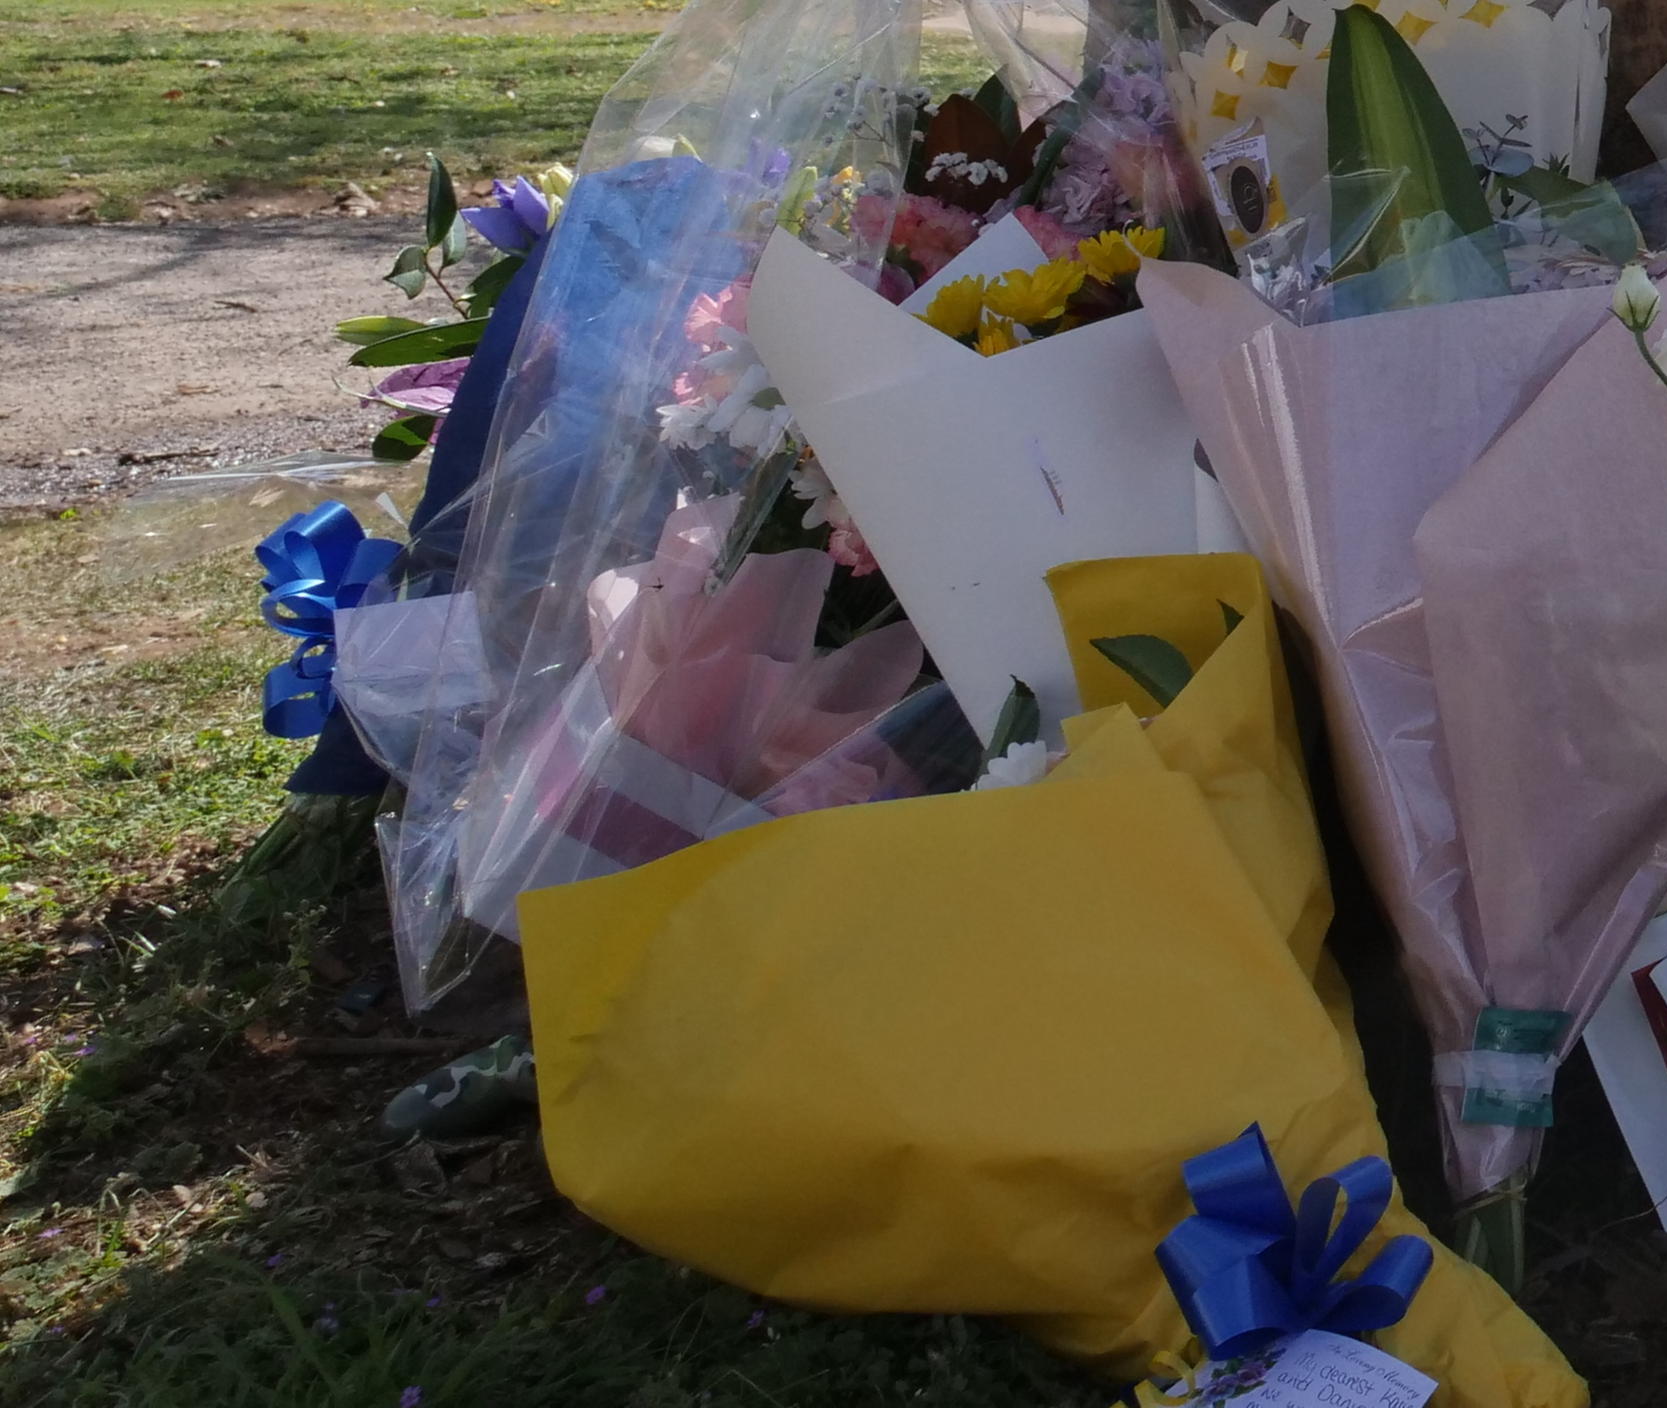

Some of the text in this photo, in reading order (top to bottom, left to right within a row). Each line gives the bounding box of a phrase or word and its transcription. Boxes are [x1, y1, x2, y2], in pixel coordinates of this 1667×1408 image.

[1277, 1371, 1313, 1392] and
[1319, 1363, 1375, 1396] dearest
[1344, 1350, 1377, 1374] Loving
[1377, 1367, 1421, 1400] Memory
